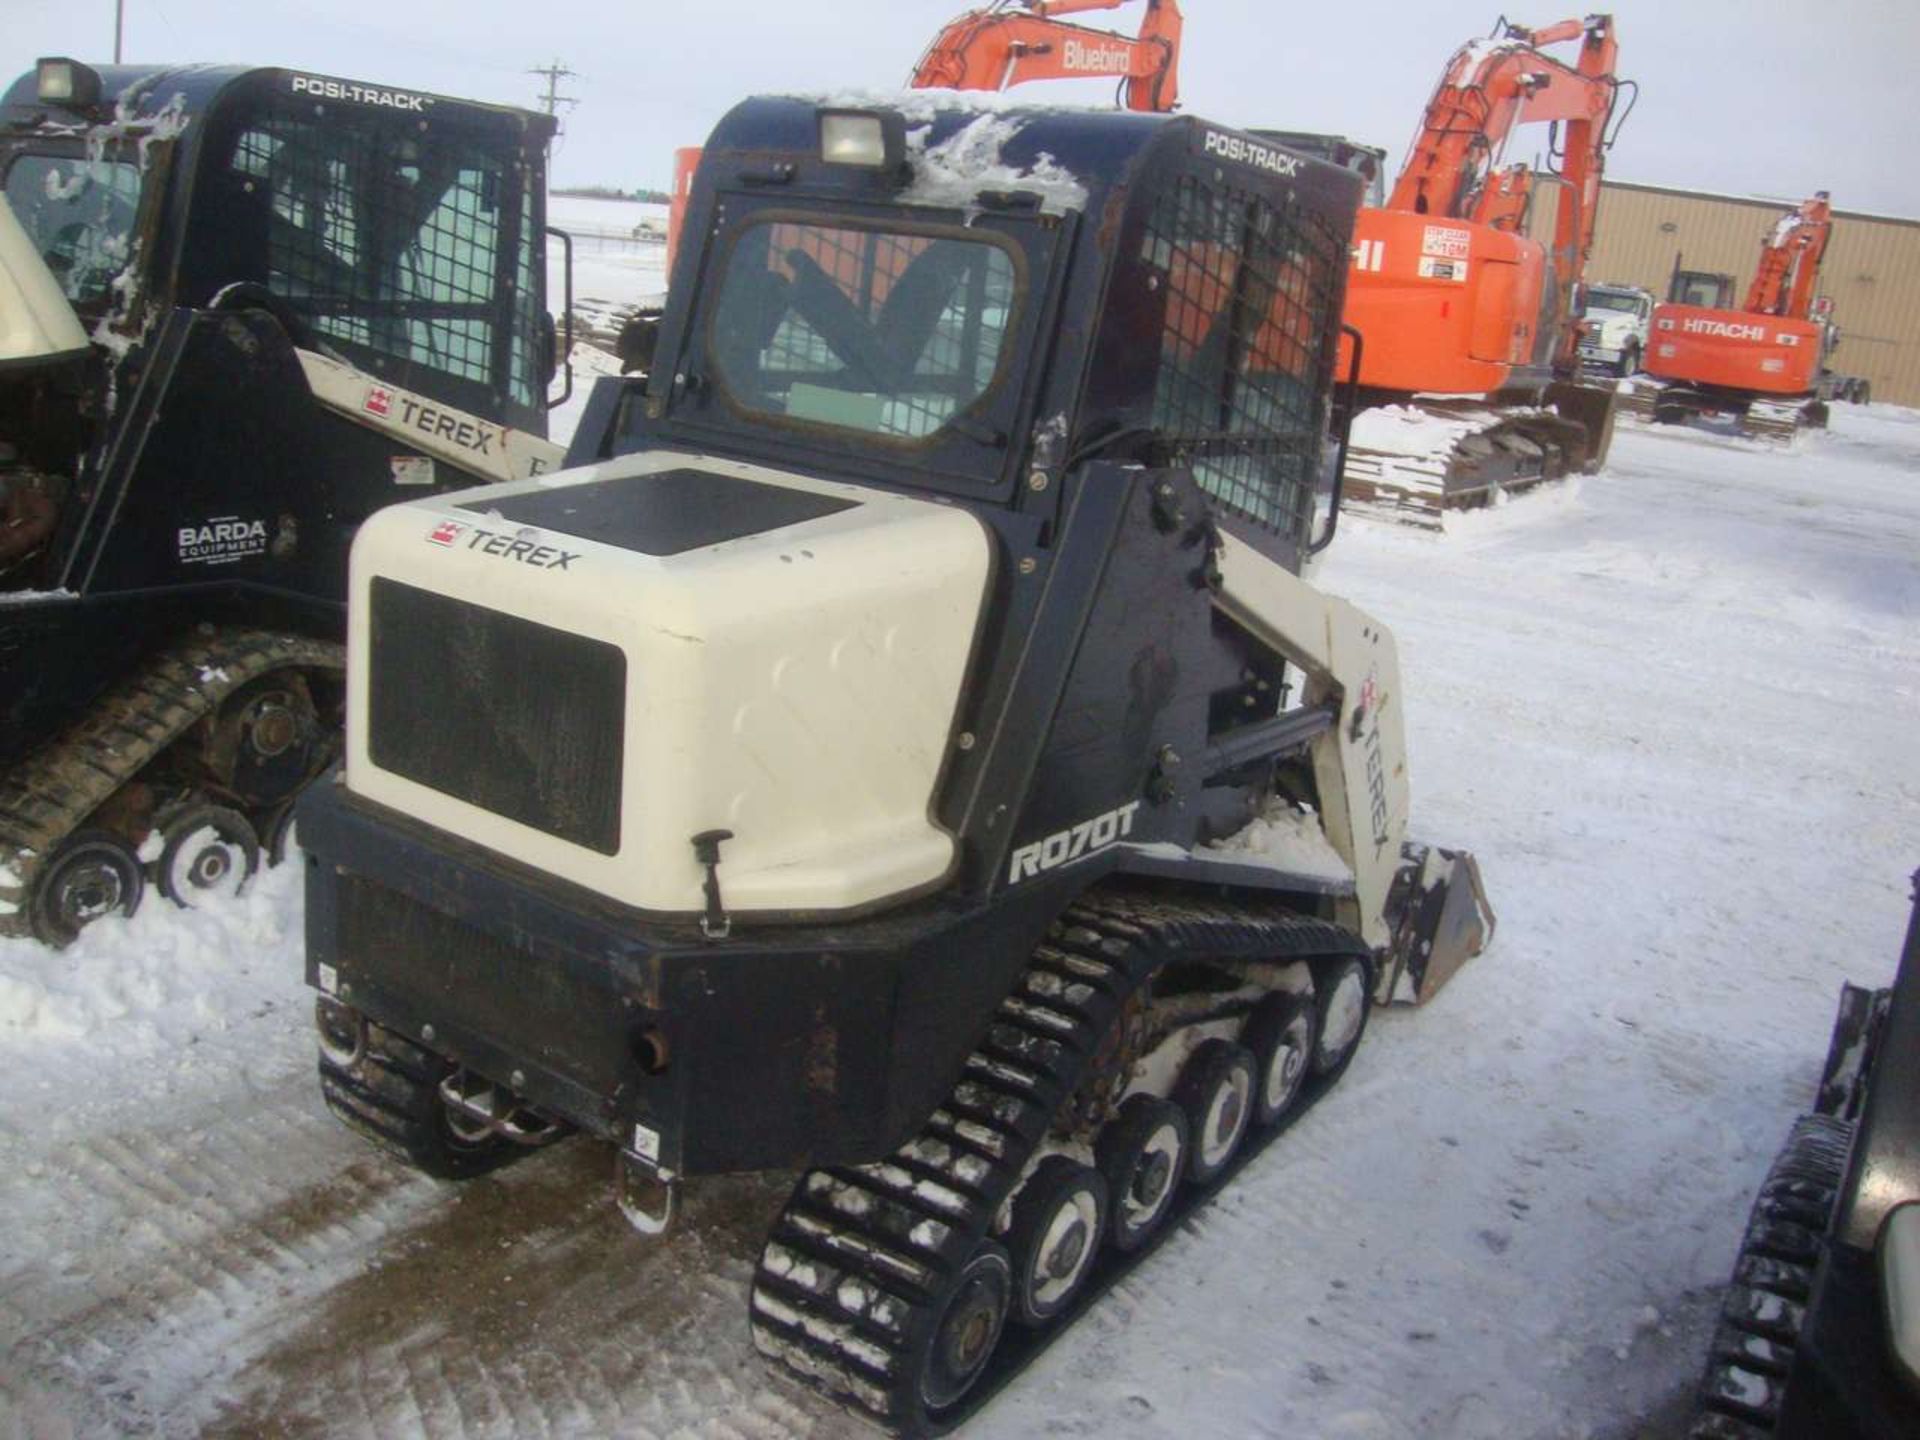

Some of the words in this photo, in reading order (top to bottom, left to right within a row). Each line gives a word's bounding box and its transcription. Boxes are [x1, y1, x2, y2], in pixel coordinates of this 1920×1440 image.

[1063, 39, 1130, 72] Bluebird
[291, 76, 424, 112] POSI-TRACK
[1204, 130, 1297, 178] POSI-TRACK
[1682, 318, 1765, 342] HITACHI
[401, 398, 494, 455] TEREX
[178, 520, 266, 547] BARDA
[178, 538, 265, 558] EQUIPMENT
[467, 529, 583, 571] TEREX
